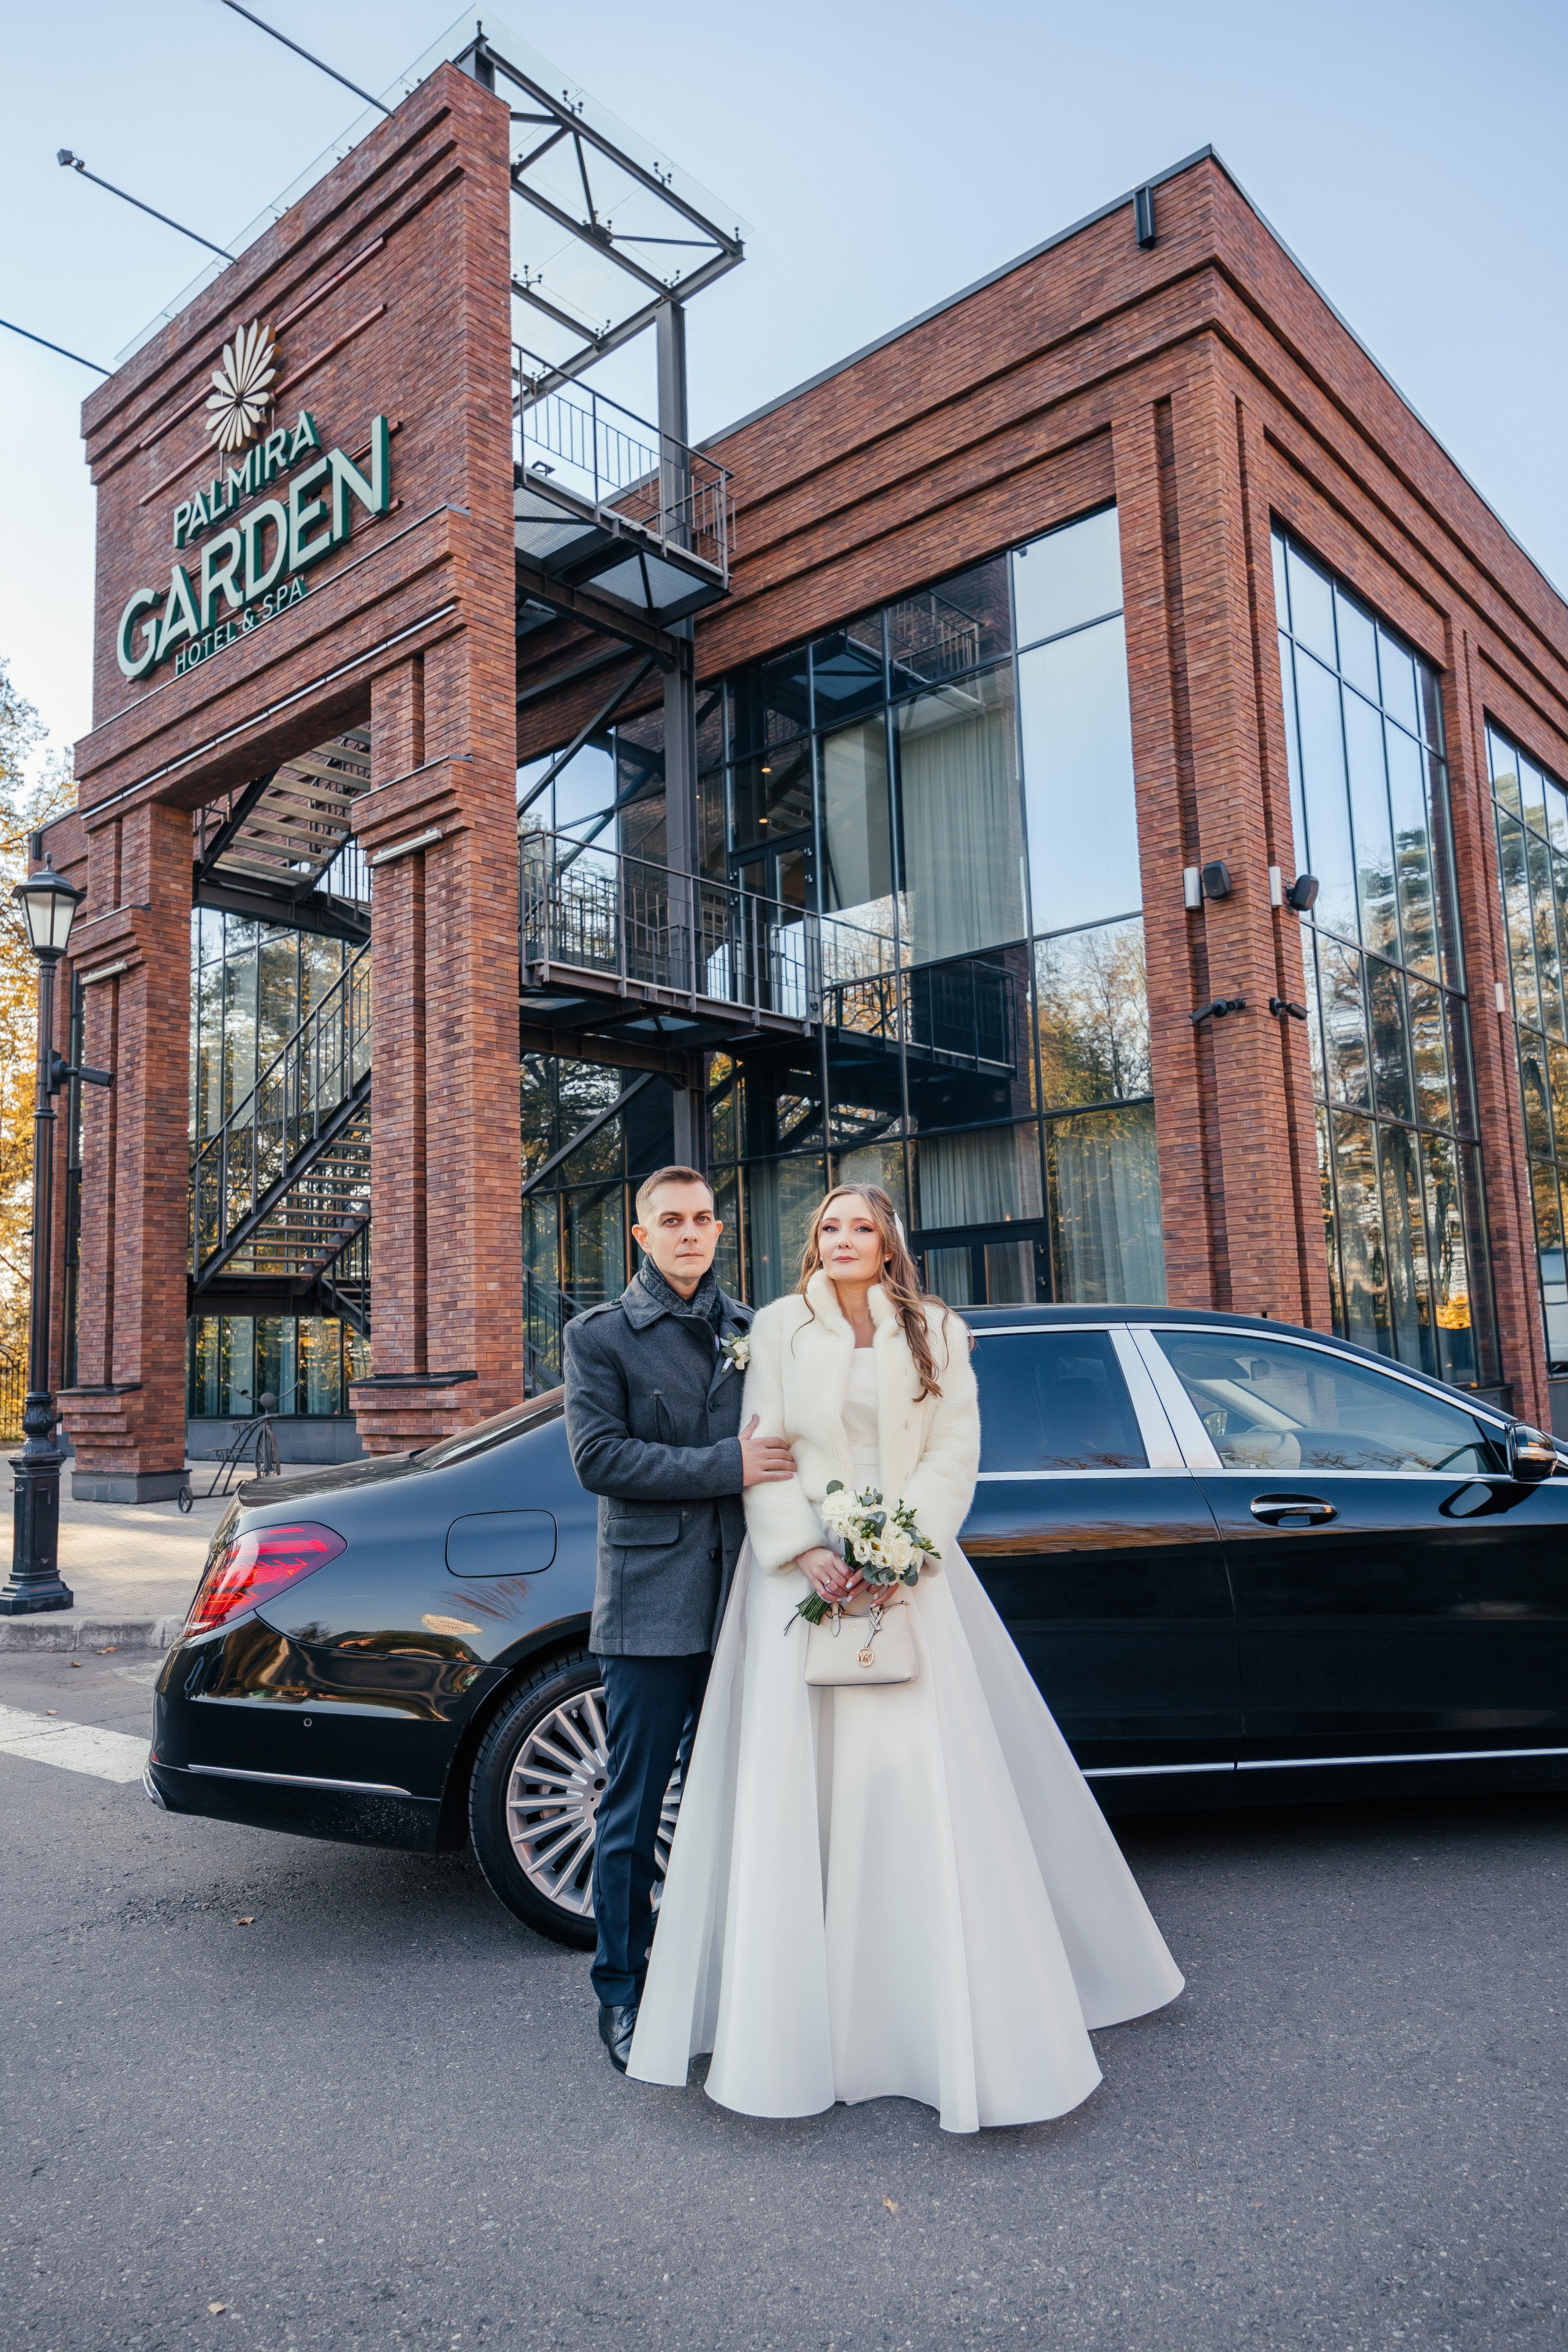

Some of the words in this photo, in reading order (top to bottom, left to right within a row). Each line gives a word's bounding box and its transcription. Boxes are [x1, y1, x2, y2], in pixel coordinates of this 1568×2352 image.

[174, 410, 320, 548] PALMIRA
[116, 415, 388, 677] GARDEN
[175, 620, 237, 676] HOTEL
[242, 608, 255, 632] &
[262, 577, 303, 619] SPA
[519, 1693, 540, 1714] 102V
